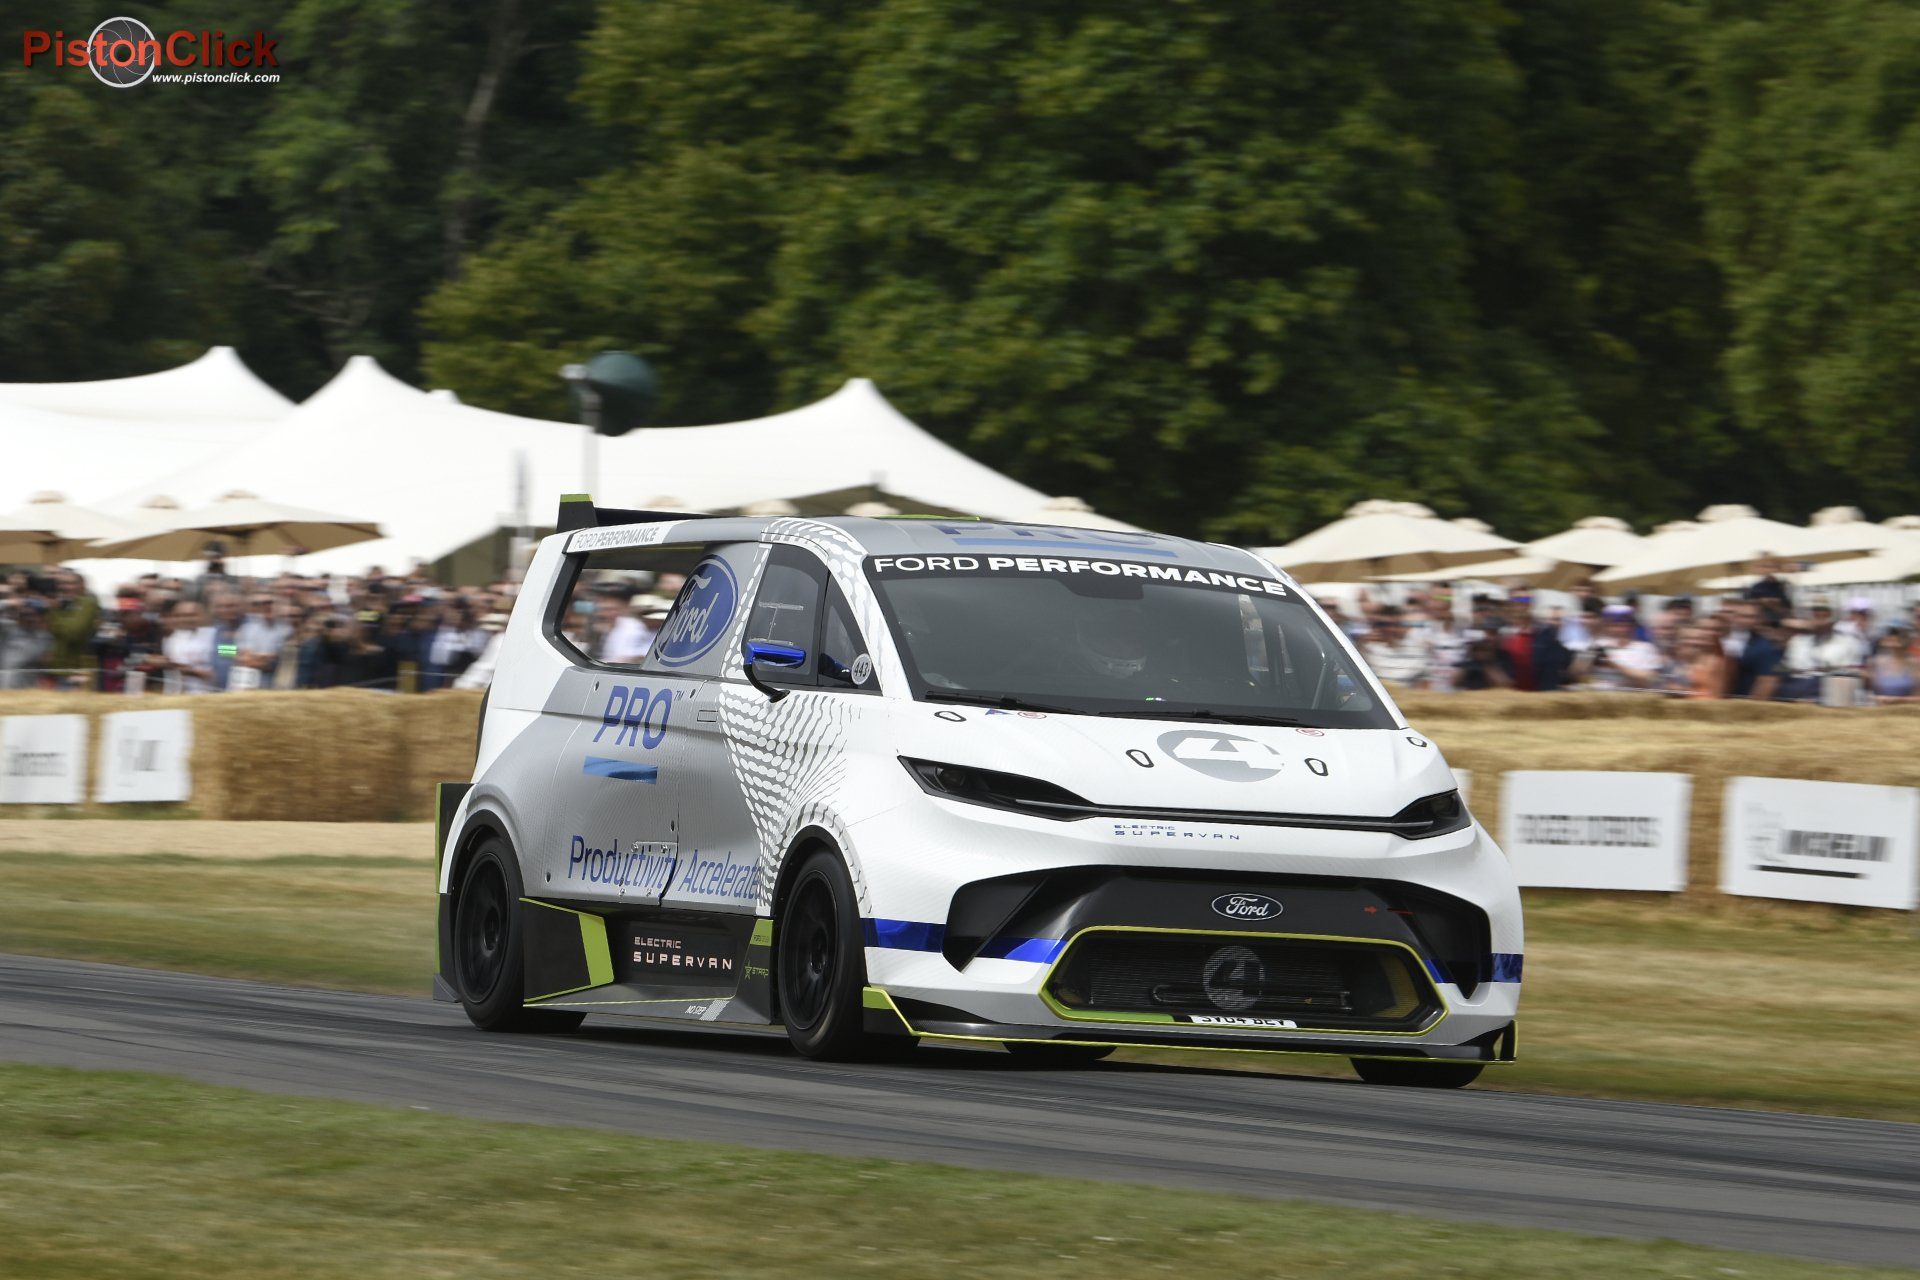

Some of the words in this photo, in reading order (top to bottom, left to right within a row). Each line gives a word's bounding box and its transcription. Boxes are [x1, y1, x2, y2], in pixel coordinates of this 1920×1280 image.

[574, 534, 598, 549] FORD
[596, 527, 660, 546] PERFORMANCE
[874, 556, 979, 573] FORD
[987, 557, 1287, 597] PERFORMANCE
[854, 661, 870, 678] 443
[592, 685, 673, 750] PRO
[1115, 830, 1240, 841] SUPERVAN
[567, 834, 684, 895] Productivity
[1225, 896, 1270, 916] Ford
[634, 936, 682, 949] ELECTRIC
[633, 951, 732, 970] SUPERVAN
